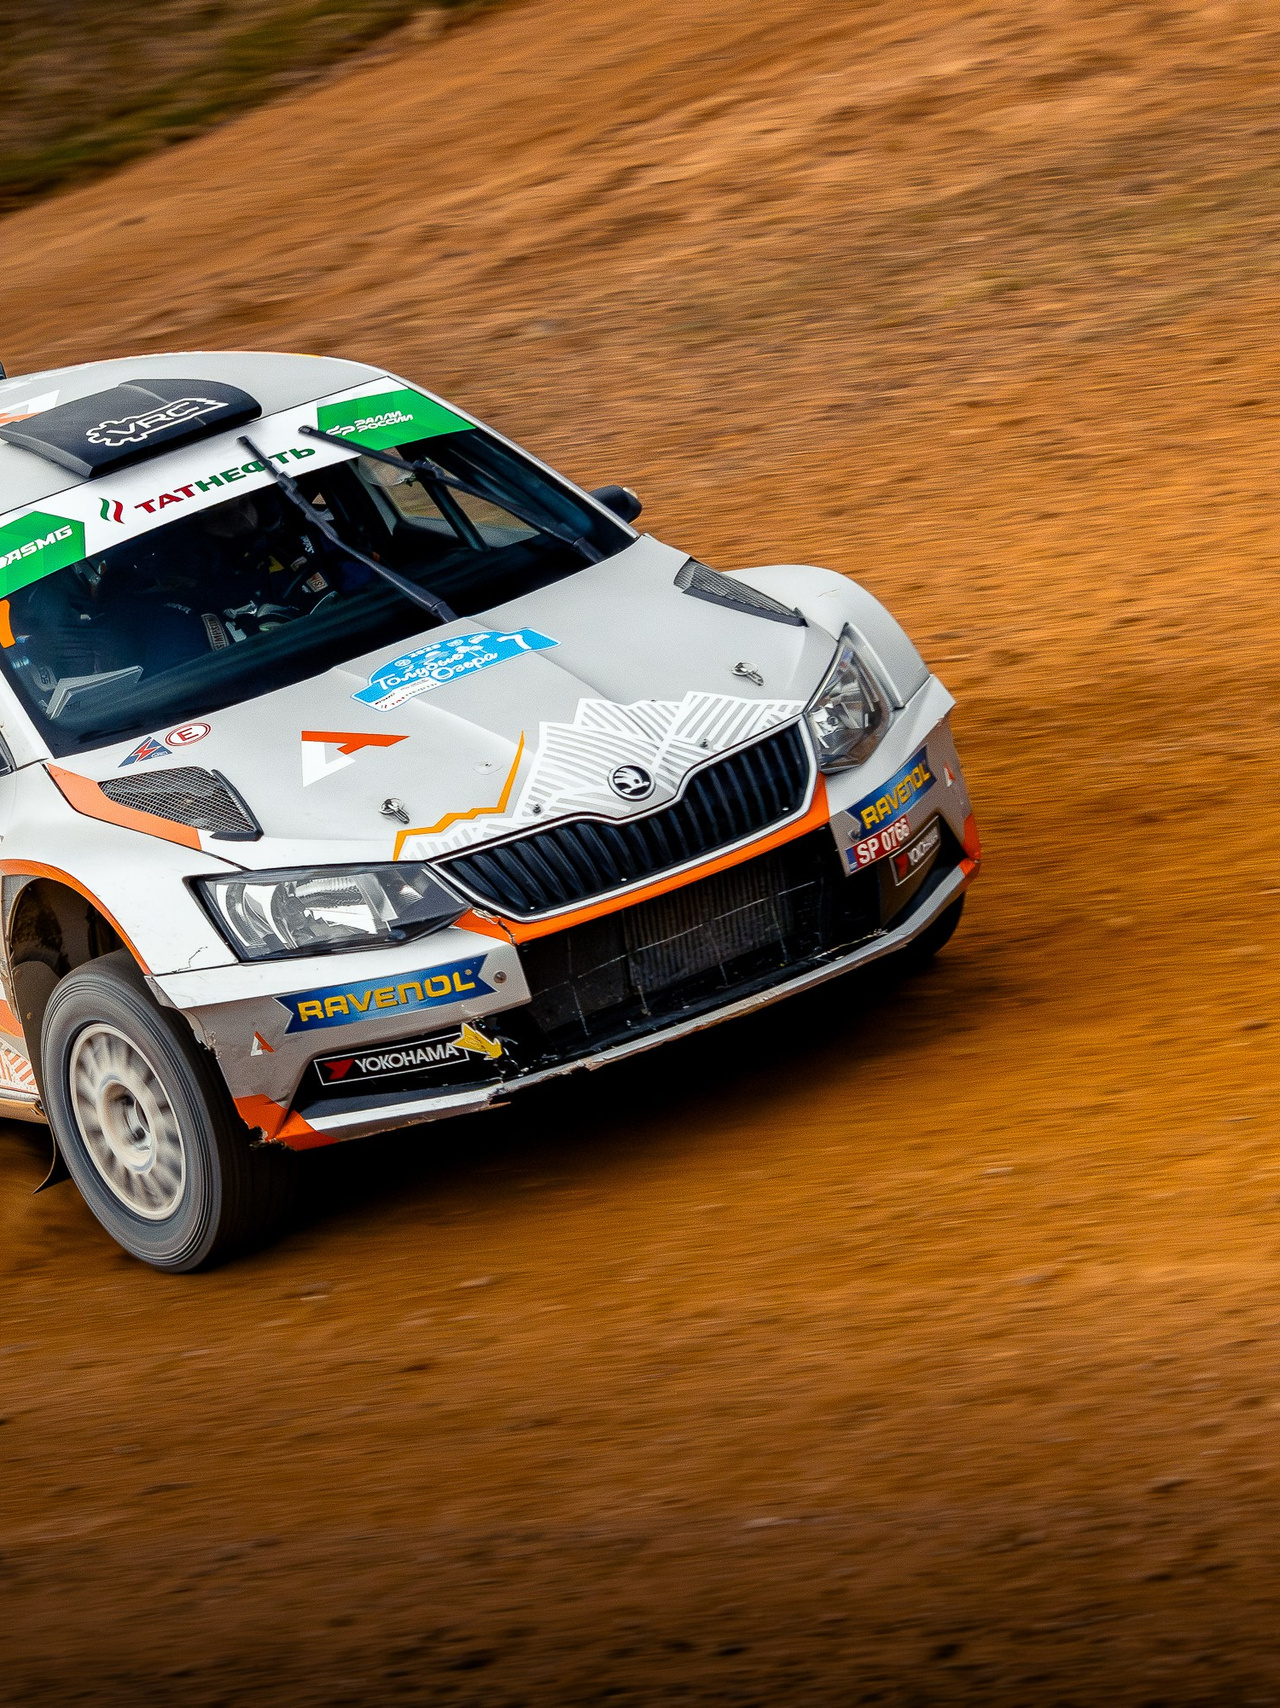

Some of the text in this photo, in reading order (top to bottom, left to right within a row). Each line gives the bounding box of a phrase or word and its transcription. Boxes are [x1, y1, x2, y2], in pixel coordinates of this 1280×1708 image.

[106, 401, 201, 435] VRC
[134, 448, 316, 514] ТАТНЕФТЬ
[497, 634, 532, 650] 7
[431, 652, 498, 680] Озера
[860, 763, 931, 830] RAVENOL
[856, 838, 880, 864] SP
[298, 972, 476, 1022] RAVENOL
[355, 1043, 460, 1074] YOKOHAMA
